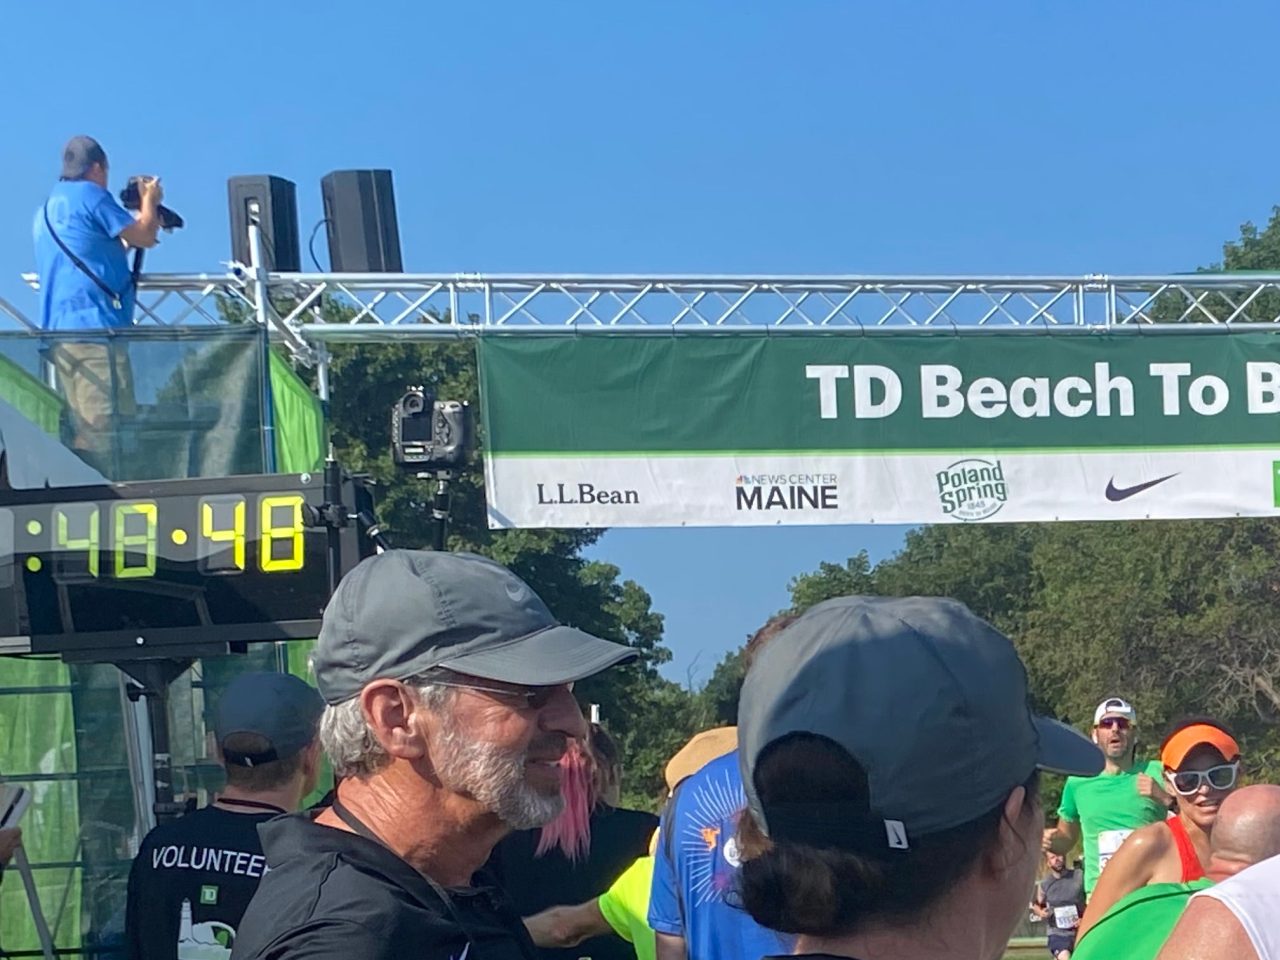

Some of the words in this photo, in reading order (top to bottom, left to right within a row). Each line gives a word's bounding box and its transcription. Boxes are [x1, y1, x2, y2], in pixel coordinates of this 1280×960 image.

[805, 364, 902, 419] TD
[920, 361, 1135, 419] Beach
[1149, 362, 1230, 416] To
[751, 474, 788, 485] NEWS
[789, 473, 838, 485] CENTER
[936, 460, 1005, 494] Poland
[536, 483, 640, 505] L.L.Bean
[735, 485, 839, 510] MAINE
[940, 482, 1008, 514] Spring
